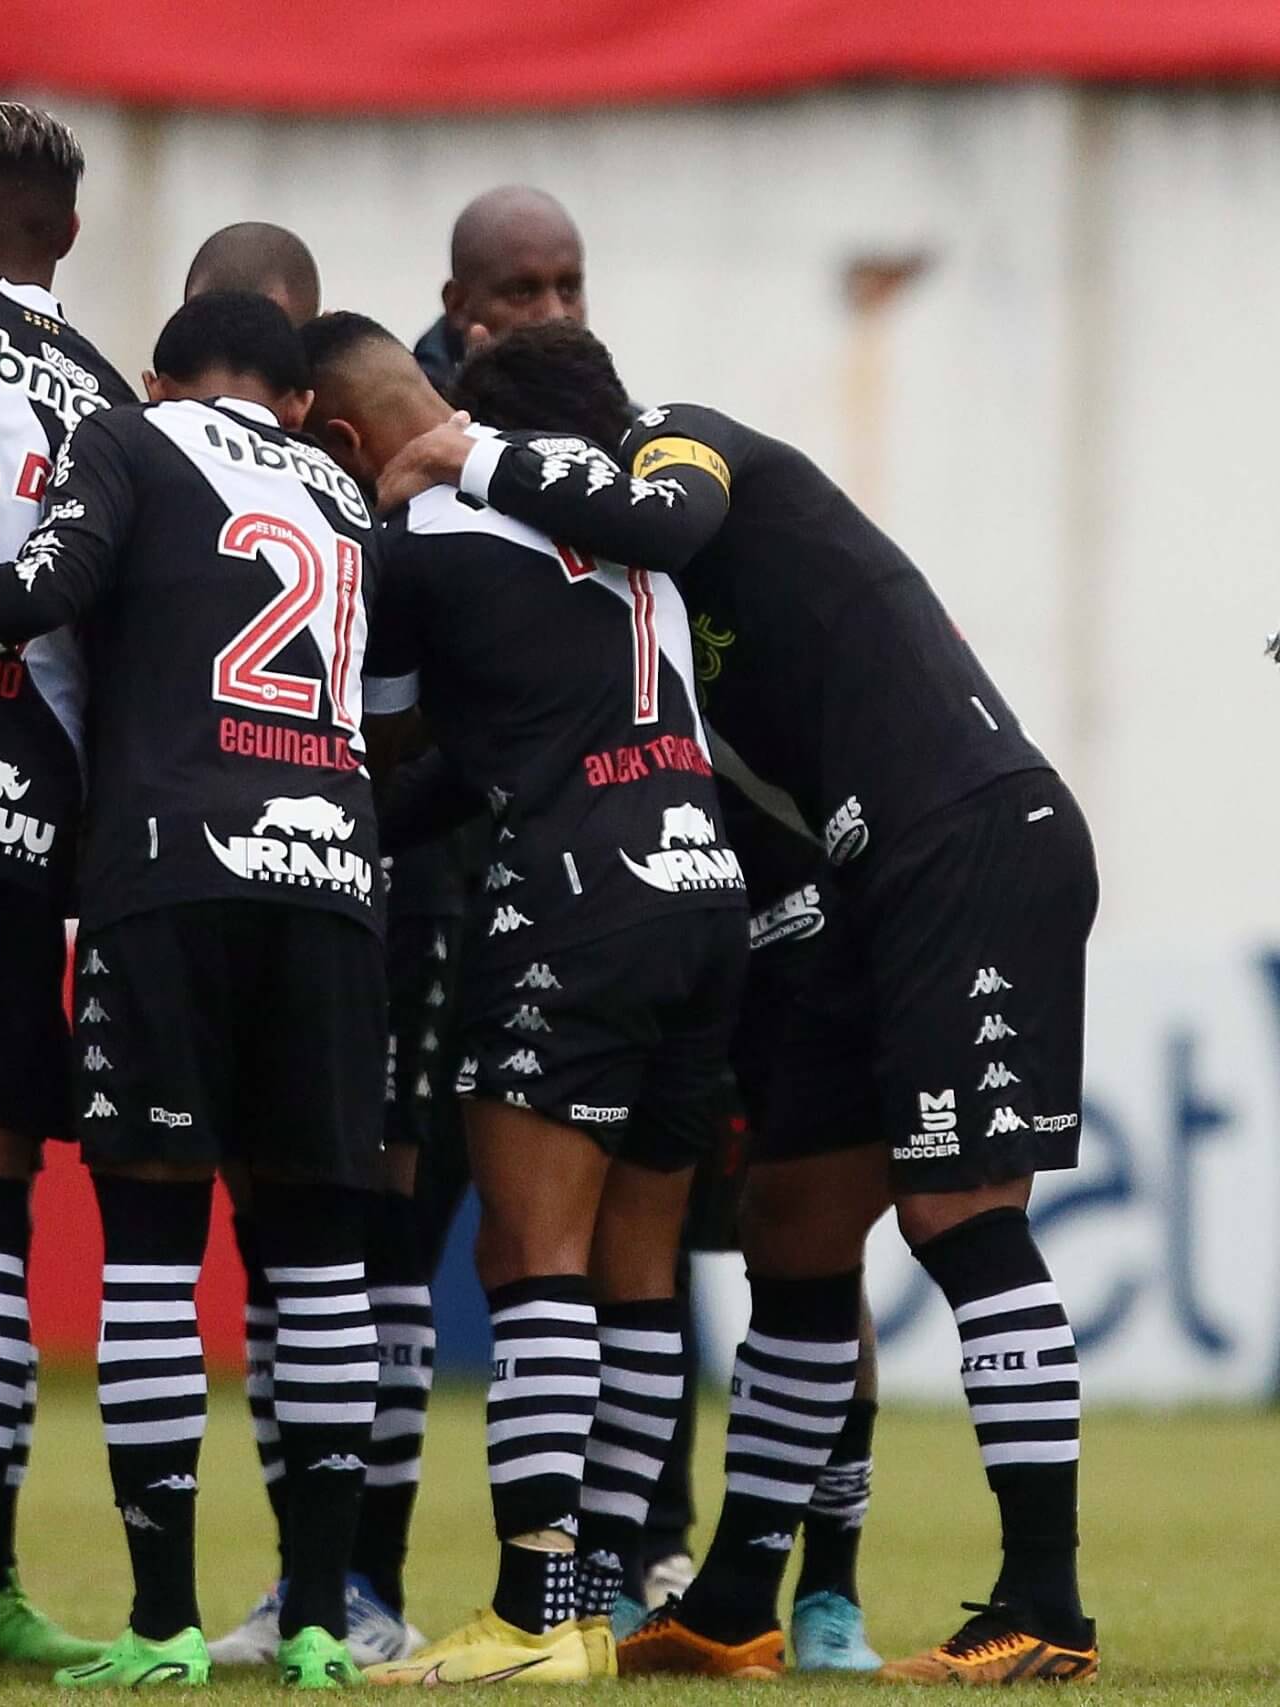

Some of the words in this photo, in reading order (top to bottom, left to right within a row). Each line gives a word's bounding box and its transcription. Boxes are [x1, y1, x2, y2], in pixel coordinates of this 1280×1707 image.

[42, 342, 98, 393] VASCO
[247, 432, 369, 522] bmg
[213, 511, 364, 732] 21
[571, 1104, 629, 1122] Kappa
[1032, 1113, 1079, 1132] Kappa
[911, 1131, 960, 1146] META
[892, 1144, 961, 1160] SOCCER
